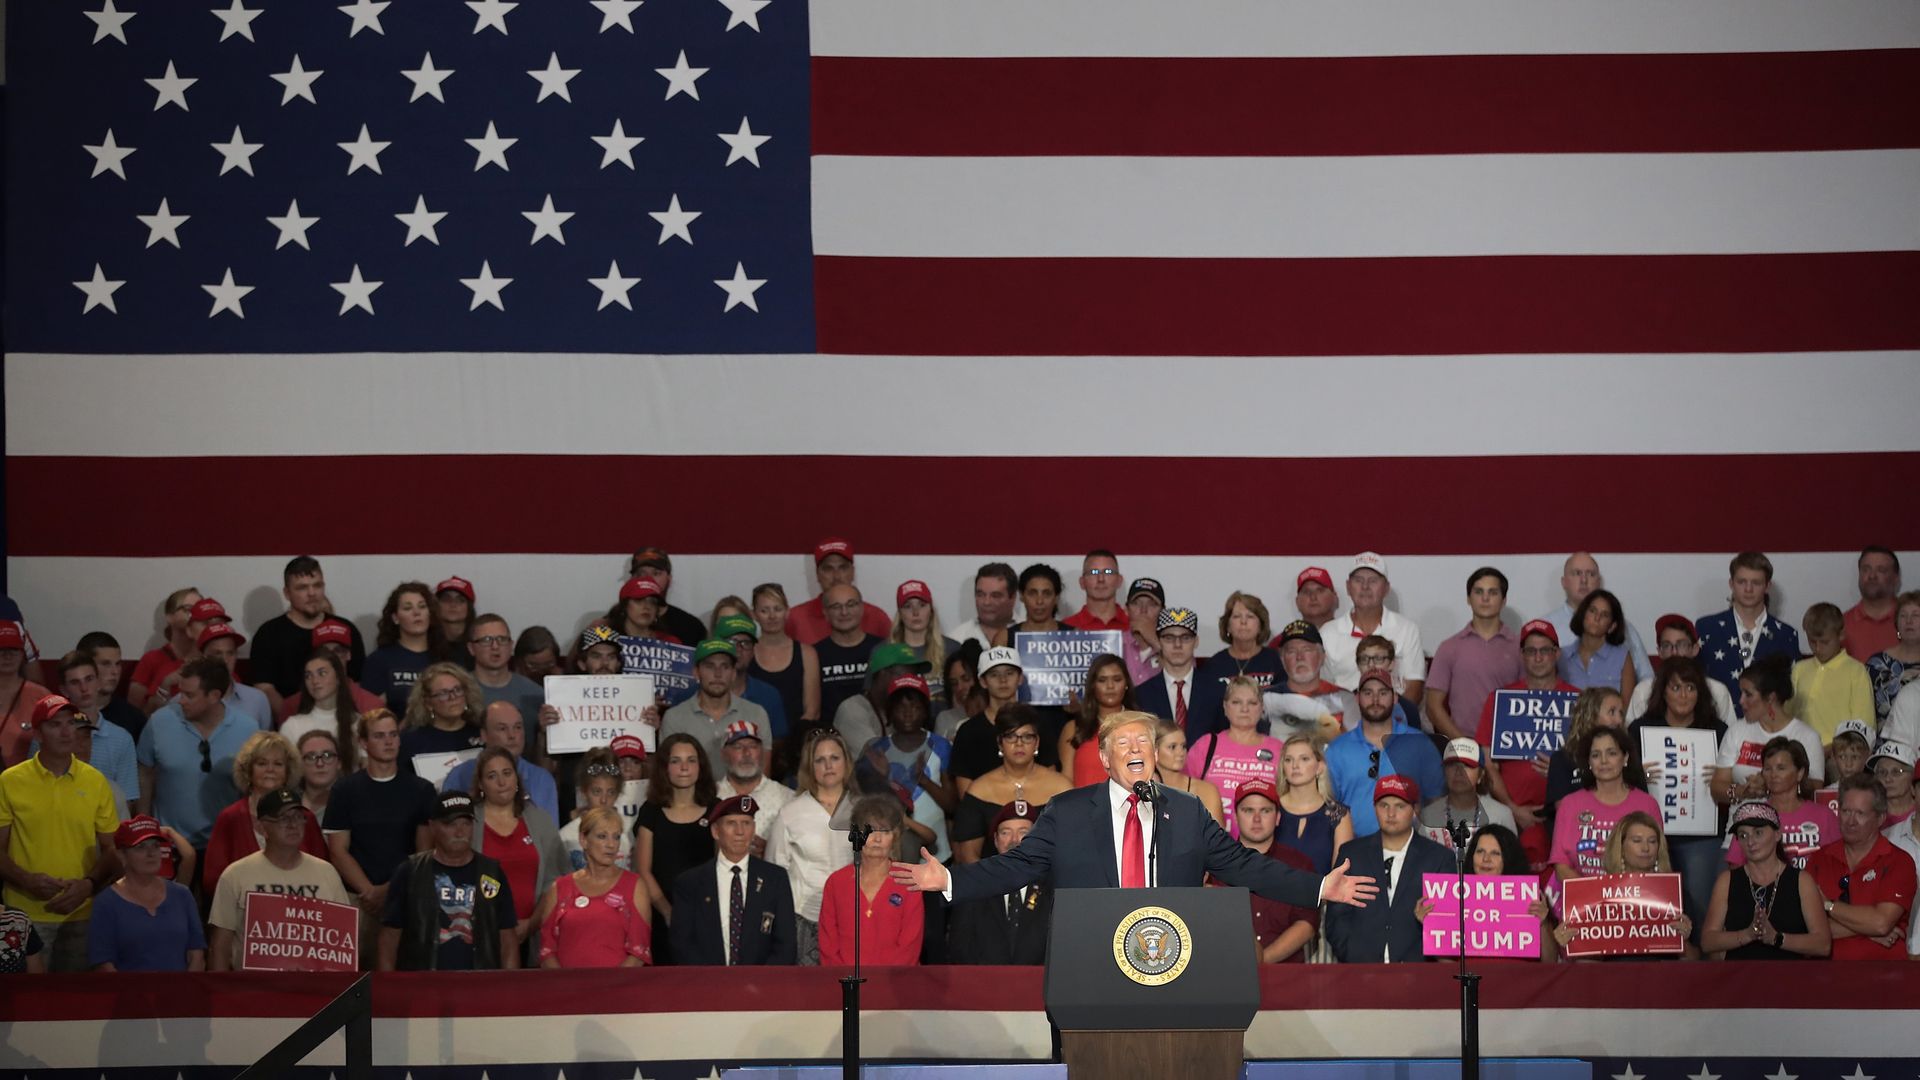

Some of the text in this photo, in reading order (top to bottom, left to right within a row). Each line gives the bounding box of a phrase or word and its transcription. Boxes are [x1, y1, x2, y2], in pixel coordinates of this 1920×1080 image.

[621, 643, 690, 664] ROMISES
[1027, 640, 1111, 654] PROMISES
[624, 655, 673, 672] MADE
[989, 650, 1012, 661] USA
[1045, 654, 1093, 668] MADE
[822, 662, 868, 676] TRUM
[1027, 672, 1089, 686] PROMIS
[583, 687, 621, 700] KEEP
[1508, 697, 1575, 719] DRAI
[1533, 718, 1563, 733] THE
[1846, 720, 1868, 736] USA
[579, 728, 626, 740] GREAT
[1499, 730, 1568, 752] SWAM
[1878, 745, 1900, 756] USA
[1214, 759, 1275, 772] TRUMP
[1664, 736, 1679, 825] TRUMP
[1679, 743, 1690, 817] PENCE
[1578, 824, 1612, 842] Tru
[1577, 853, 1601, 868] Pen
[1424, 880, 1539, 902] WOMEN
[1601, 886, 1642, 900] MAKE
[285, 907, 323, 923] MAKE
[1463, 909, 1501, 924] FOR
[1568, 901, 1678, 924] AMERICA
[248, 921, 355, 950] AMERICA
[1116, 910, 1150, 945] PRESIDENT
[1172, 917, 1191, 951] UNITED
[1571, 923, 1678, 941] ROUD AGAIN
[1430, 929, 1534, 951] TRUMP
[249, 942, 354, 966] PROUD AGAIN
[1127, 967, 1147, 982] SEAL
[1161, 958, 1188, 982] STATES
